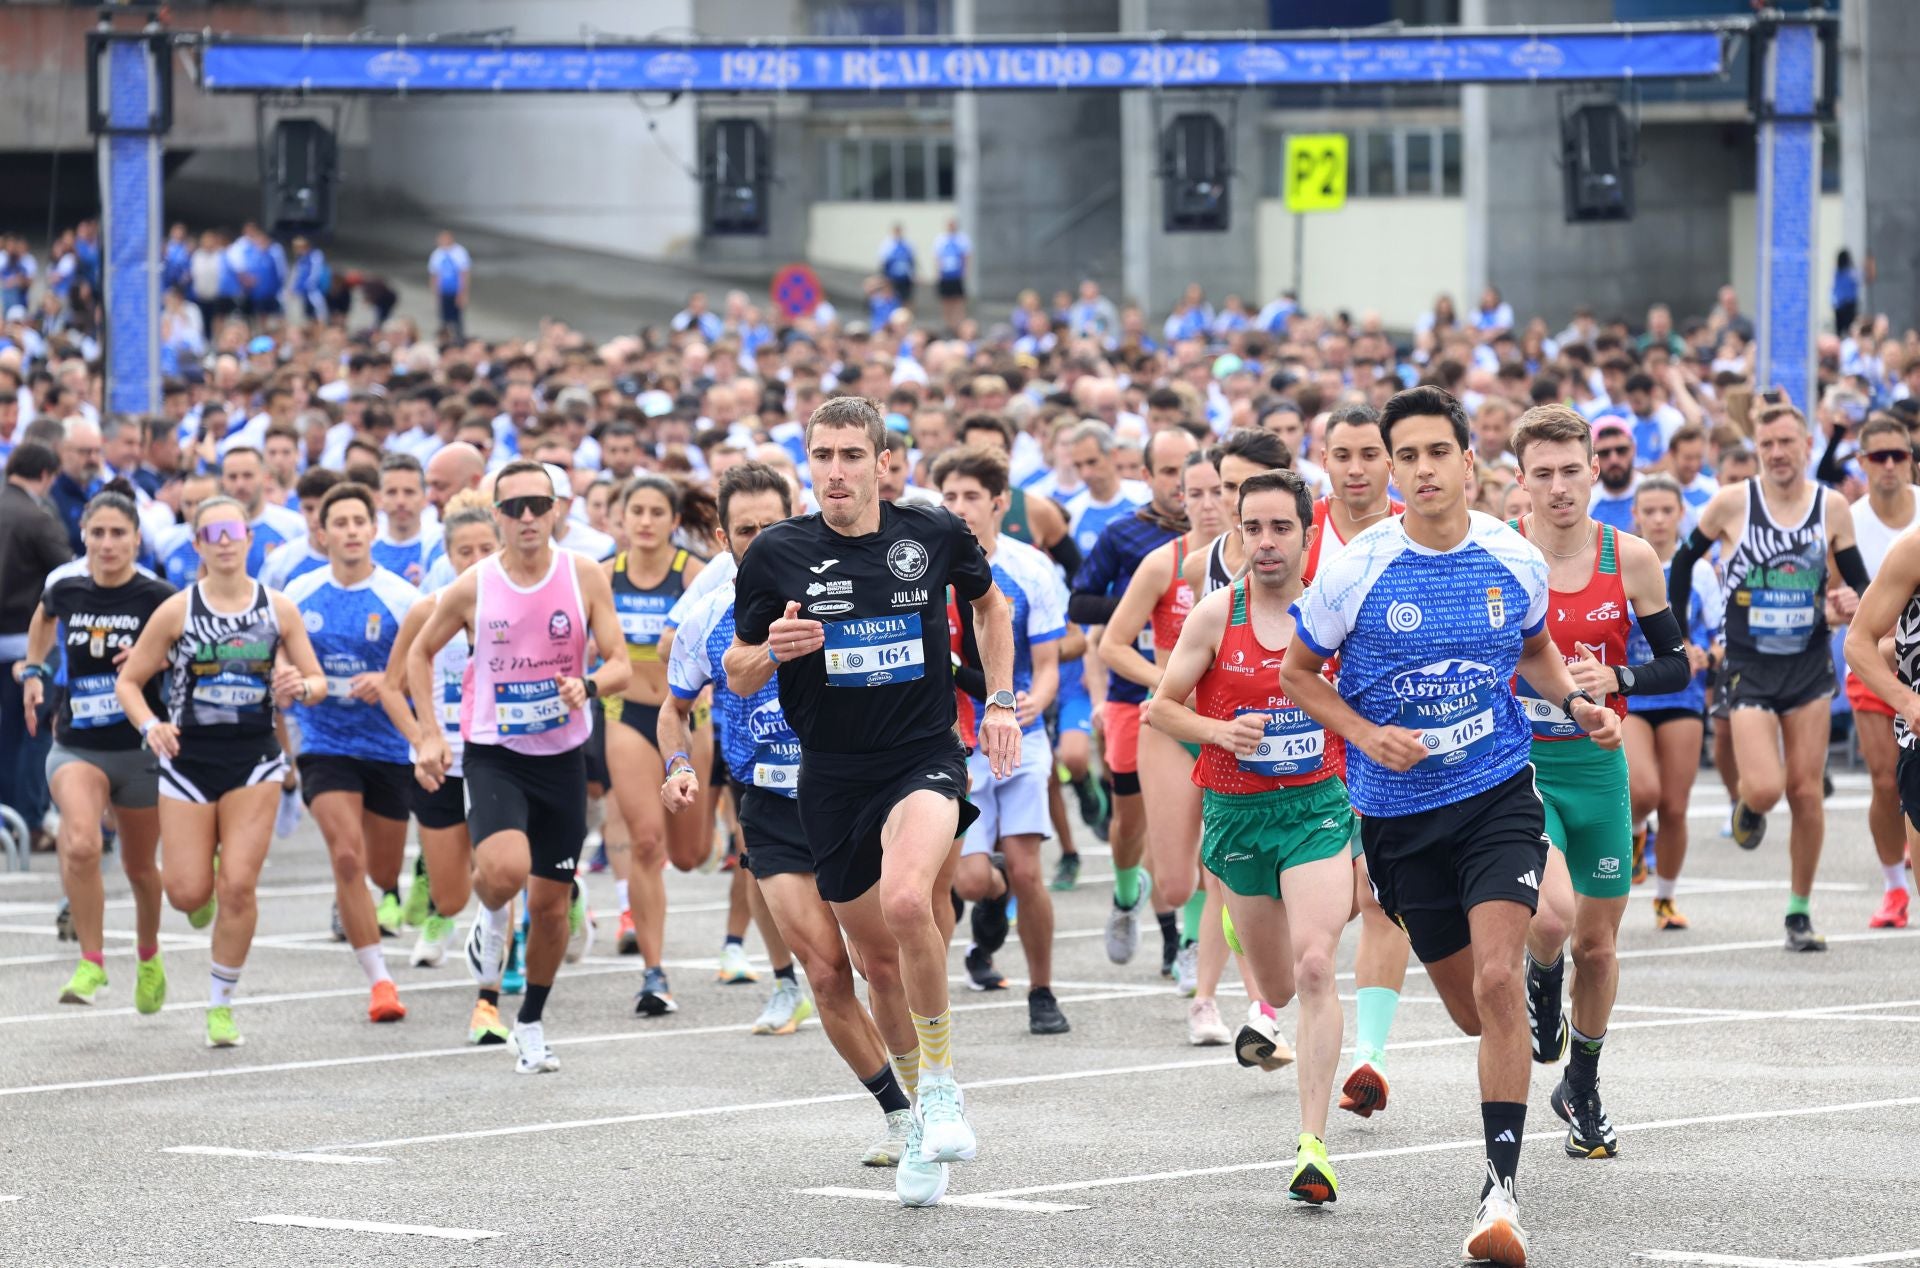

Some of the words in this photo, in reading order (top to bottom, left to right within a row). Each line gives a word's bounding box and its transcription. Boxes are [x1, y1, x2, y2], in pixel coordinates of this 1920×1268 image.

[721, 52, 801, 82] 1926
[1131, 47, 1220, 79] 2026
[1294, 150, 1342, 196] P2
[826, 580, 852, 588] MAYBE
[891, 588, 928, 604] JULIÁN
[1763, 591, 1806, 603] MARCHA
[843, 619, 907, 635] MARCHA
[878, 646, 911, 666] 164
[1416, 692, 1479, 716] MARCHA
[1451, 718, 1484, 746] 405
[1283, 736, 1317, 757] 430
[1593, 871, 1621, 879] Llanes
